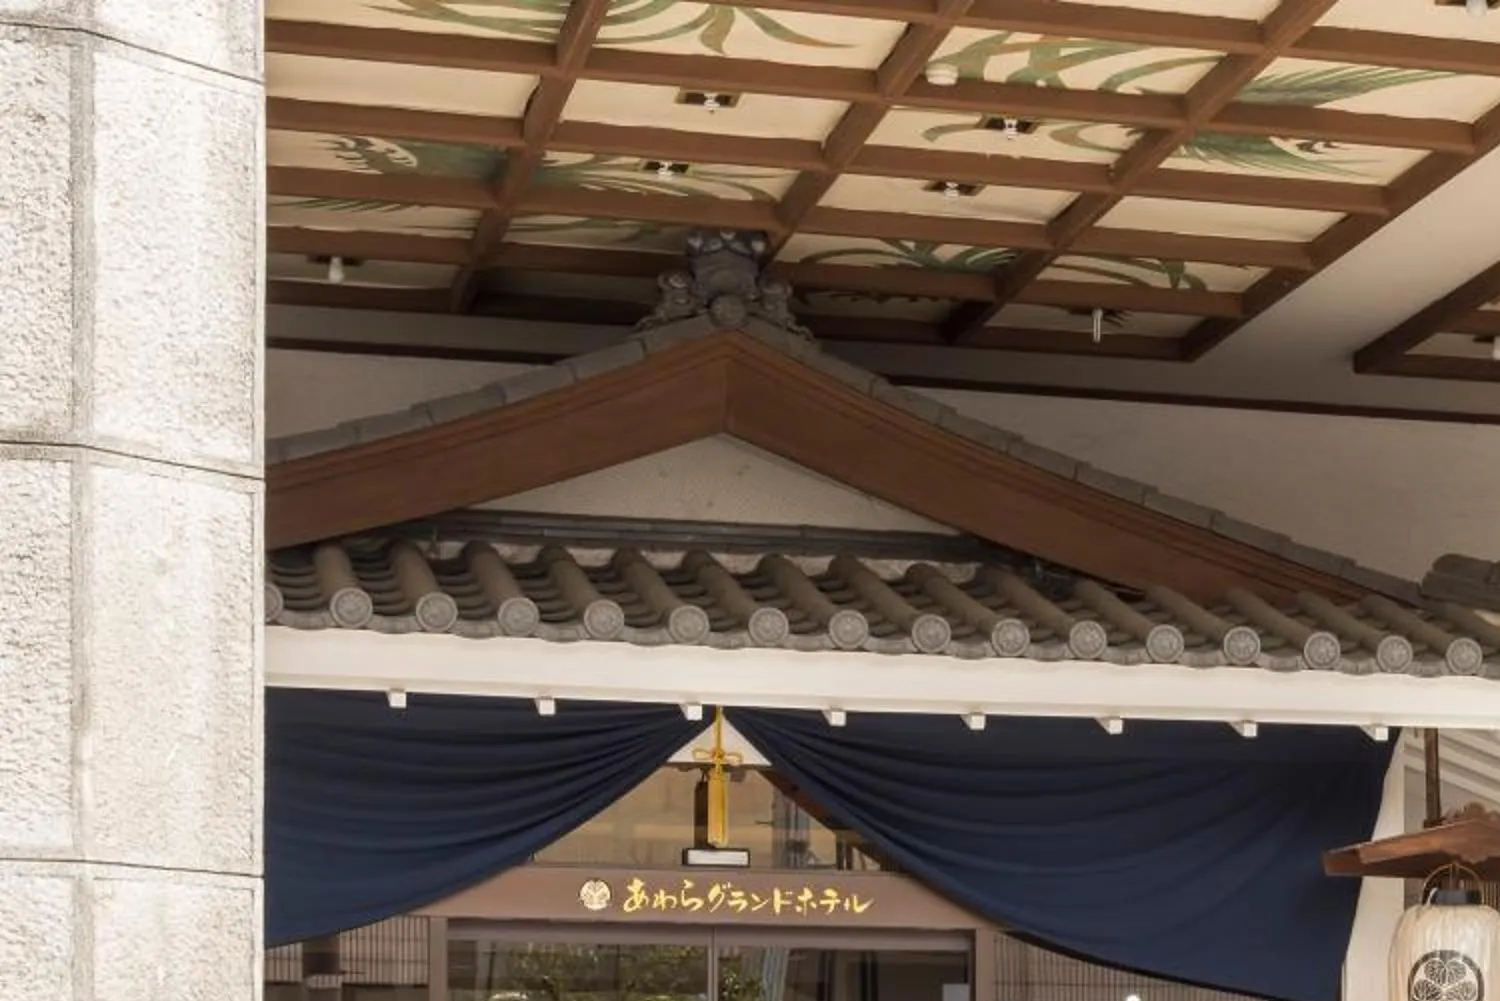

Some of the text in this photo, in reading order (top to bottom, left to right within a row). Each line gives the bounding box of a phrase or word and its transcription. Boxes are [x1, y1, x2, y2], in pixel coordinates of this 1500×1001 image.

[623, 877, 875, 915] あわらグランドホテル
